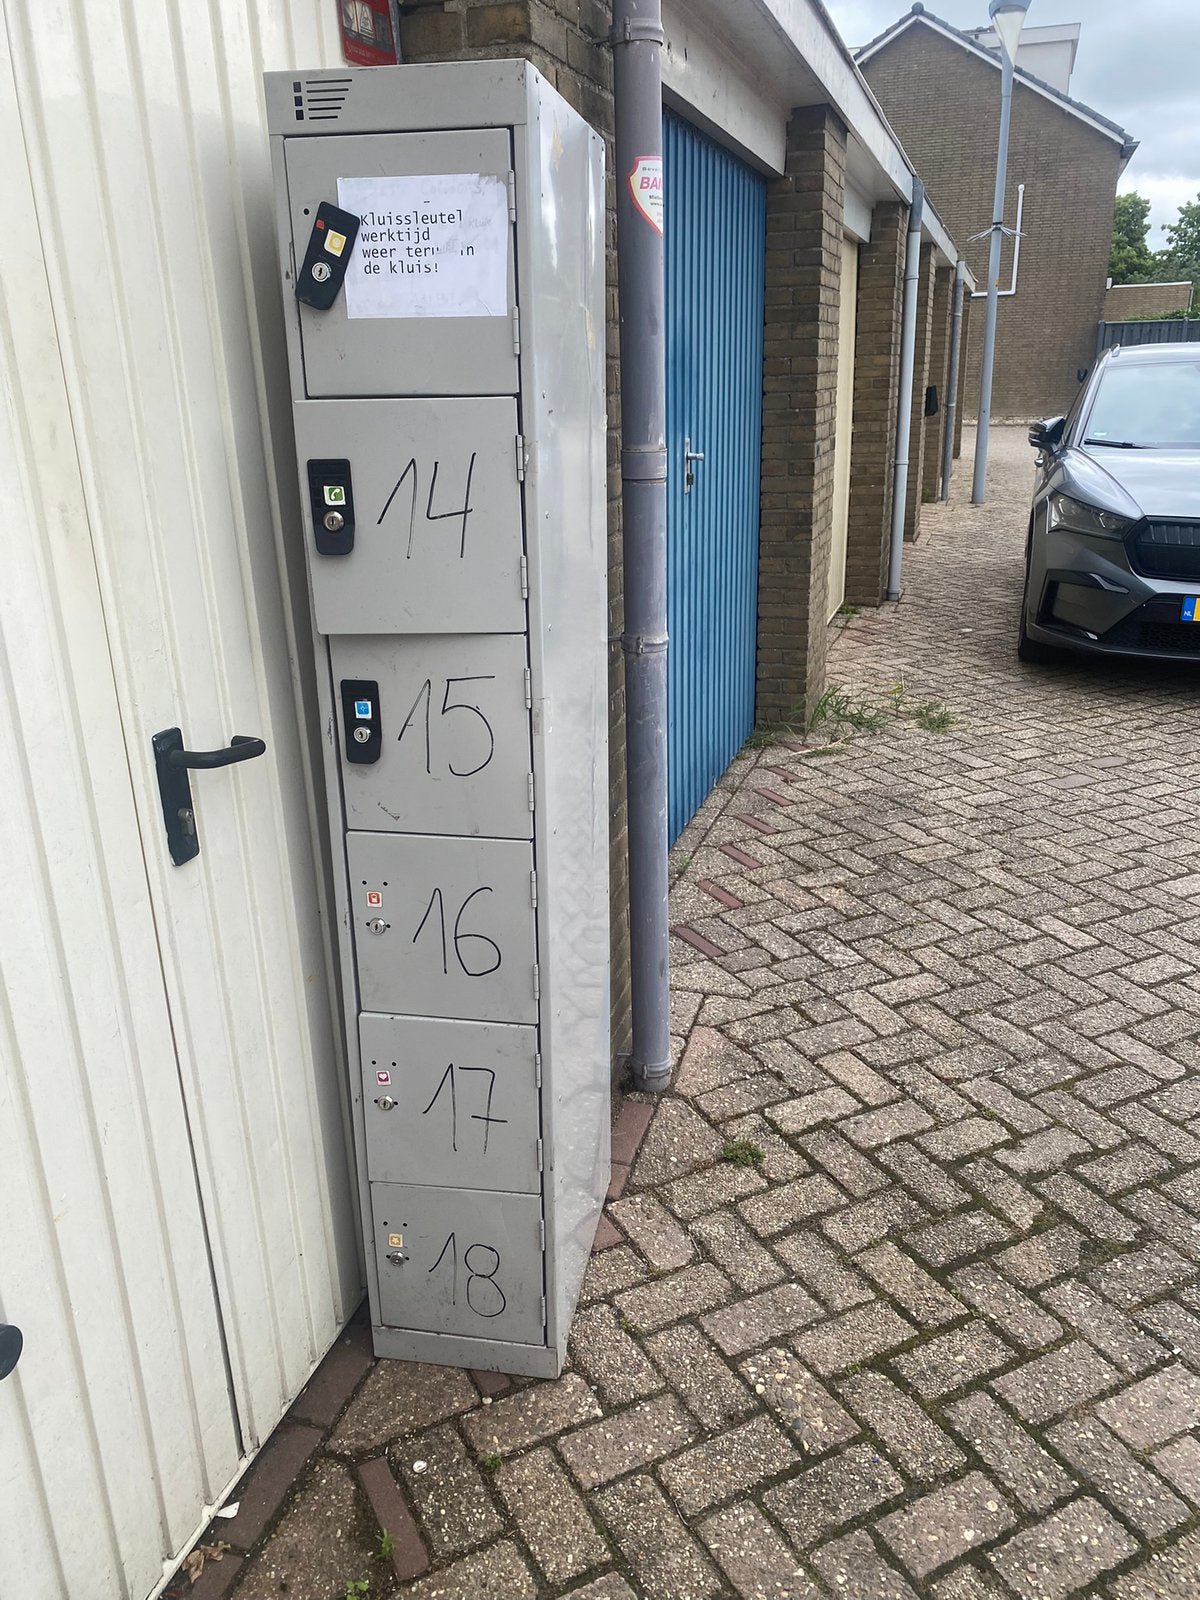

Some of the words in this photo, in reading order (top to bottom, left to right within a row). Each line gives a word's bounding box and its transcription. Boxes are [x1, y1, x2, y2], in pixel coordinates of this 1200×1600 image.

[360, 209, 463, 226] Kluissleutel
[361, 227, 430, 244] werktijd
[362, 247, 397, 259] weer
[364, 262, 381, 275] de
[389, 260, 439, 274] kluis!
[376, 451, 477, 560] 14
[397, 675, 496, 777] 15
[412, 886, 502, 977] 16
[422, 1063, 508, 1155] 17
[428, 1231, 507, 1318] 18
